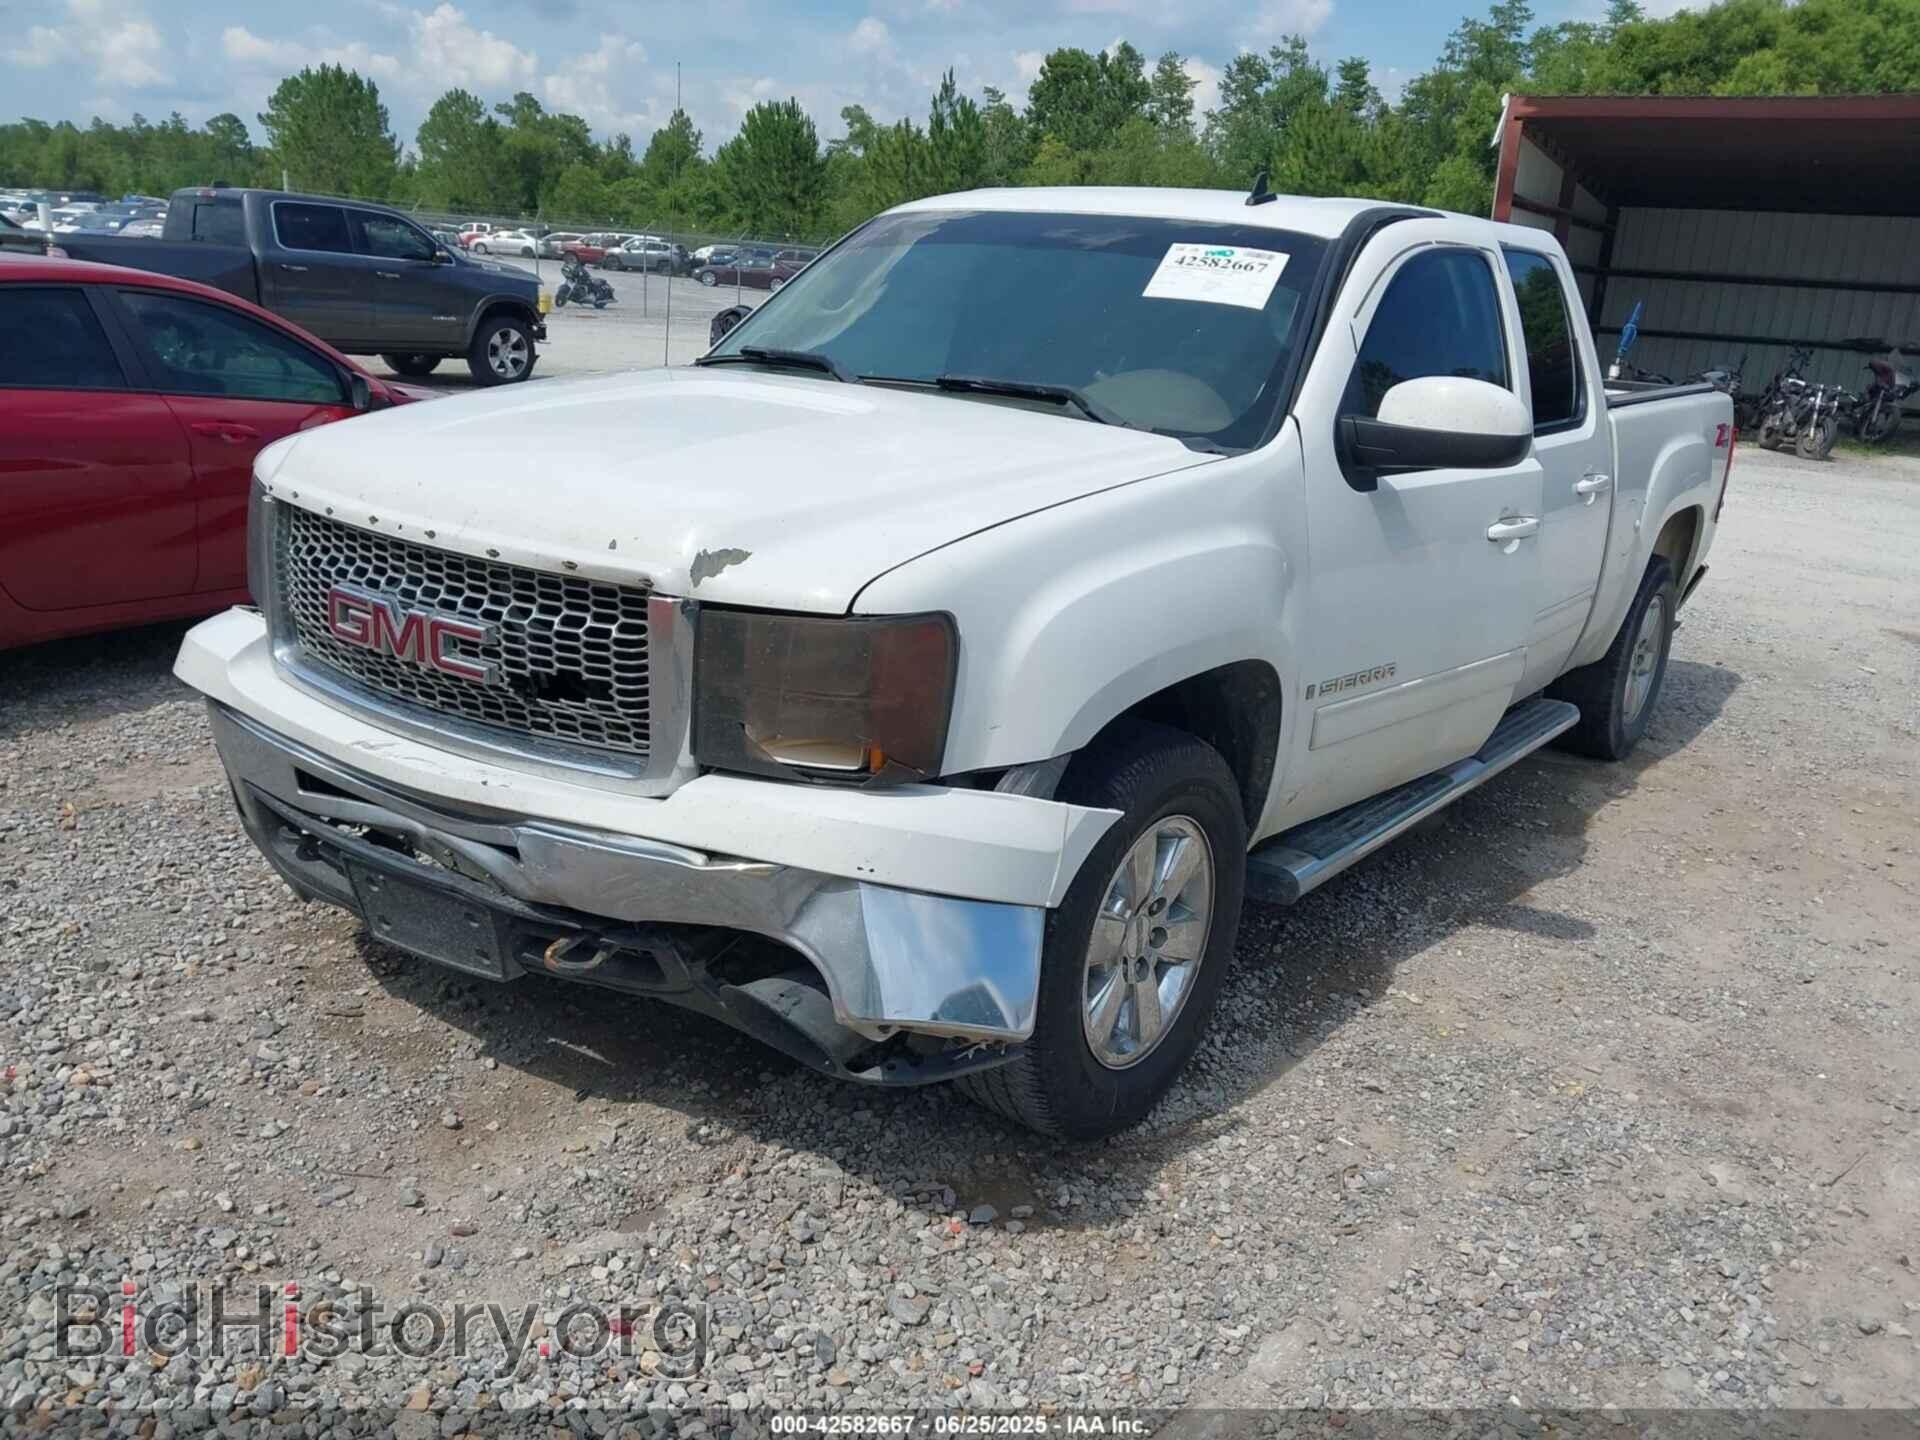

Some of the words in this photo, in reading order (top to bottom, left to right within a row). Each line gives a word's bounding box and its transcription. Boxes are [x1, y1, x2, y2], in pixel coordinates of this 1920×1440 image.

[1174, 255, 1269, 273] 42582667
[328, 583, 500, 686] GMC
[1319, 661, 1397, 697] SIERRA
